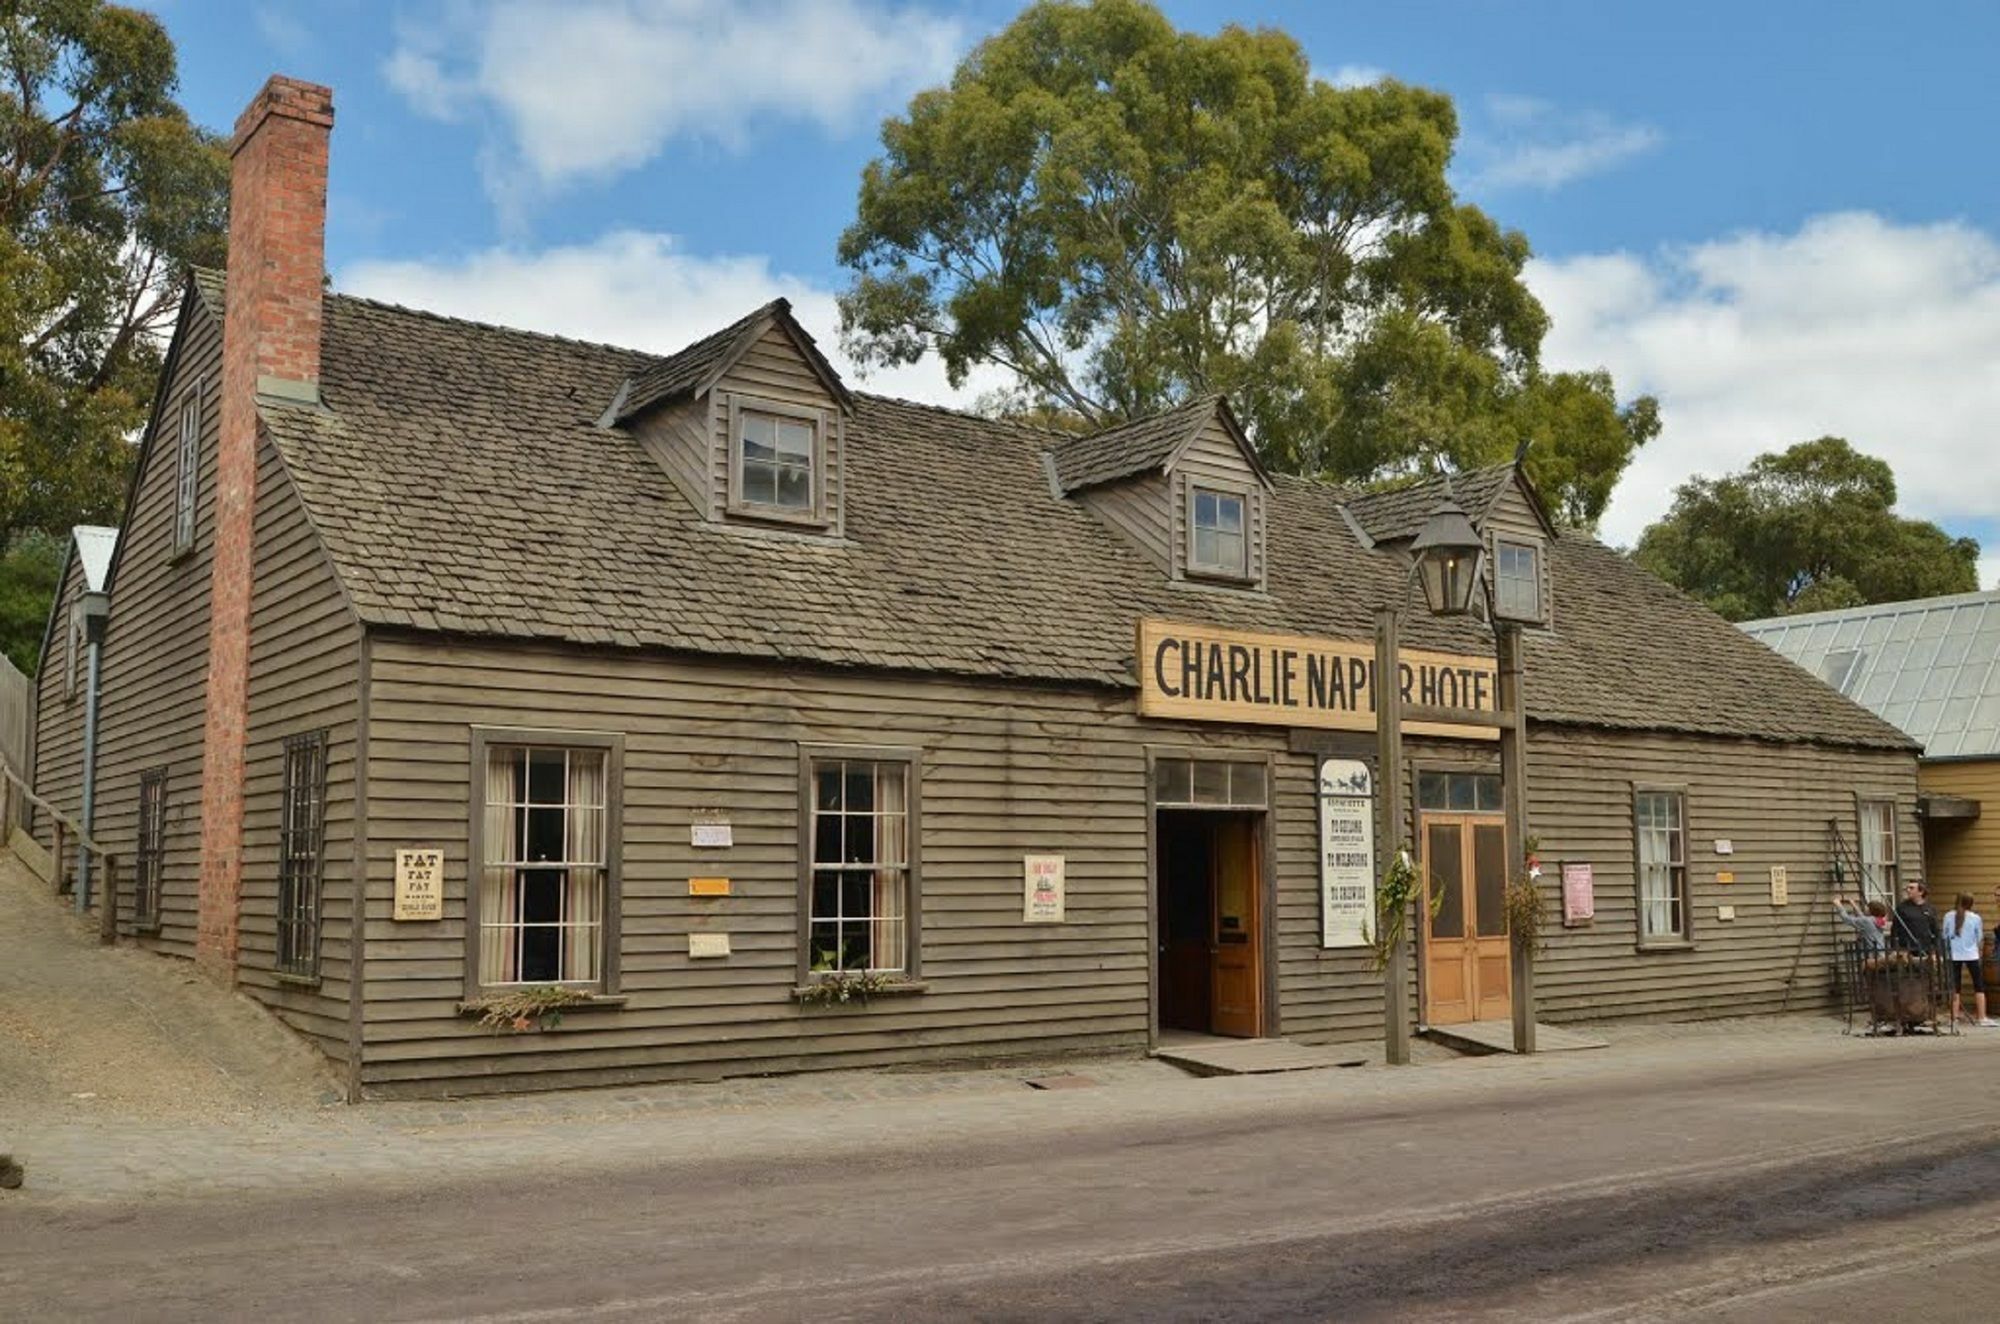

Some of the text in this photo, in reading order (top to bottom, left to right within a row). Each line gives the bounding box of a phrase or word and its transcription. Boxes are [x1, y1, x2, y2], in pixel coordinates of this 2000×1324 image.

[1155, 637, 1298, 706] CHARLIE
[1307, 653, 1414, 713] NAPIR
[404, 855, 438, 867] FAT
[408, 870, 432, 880] FAT
